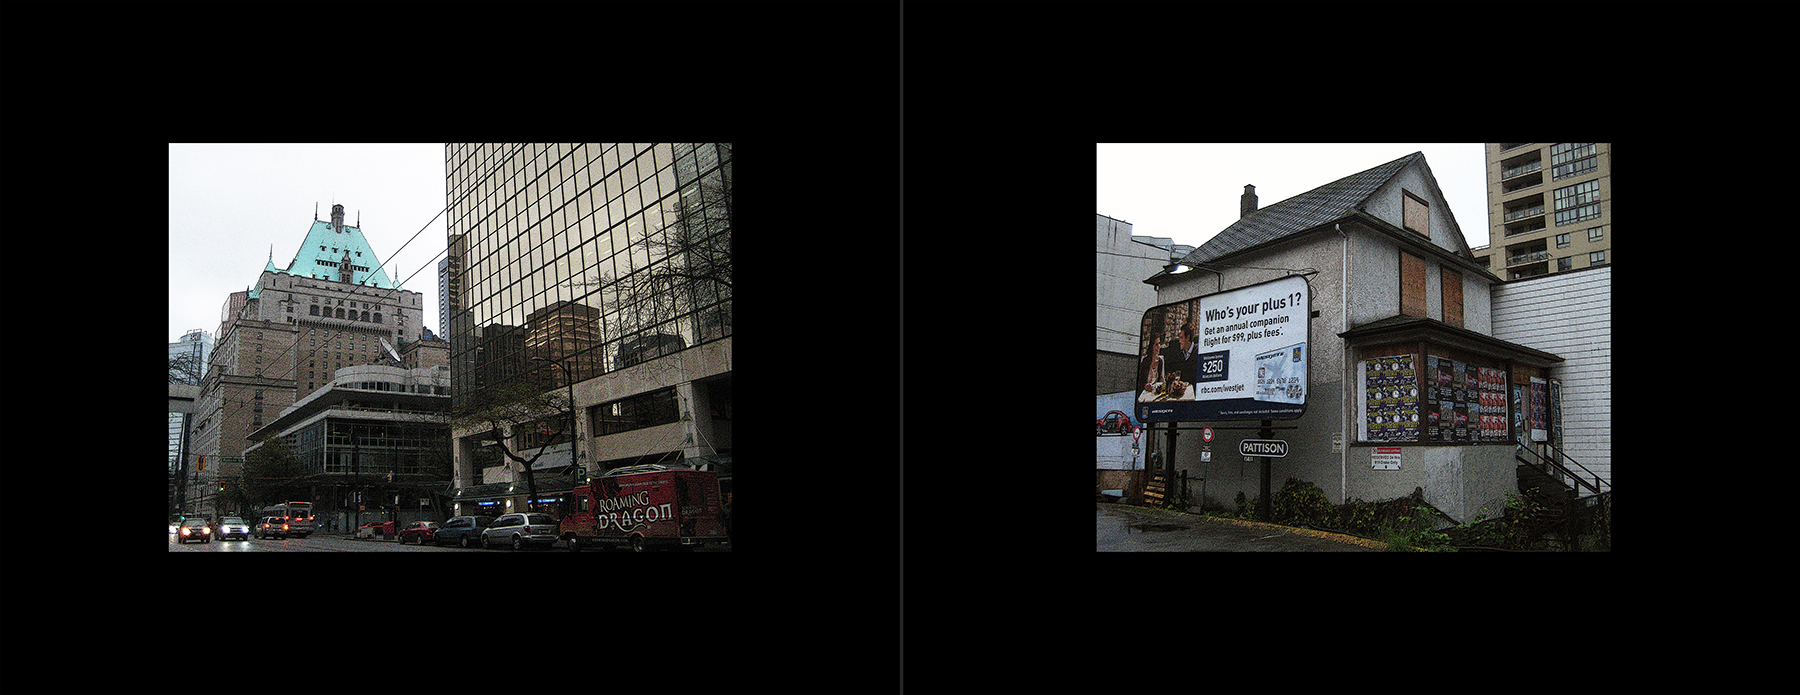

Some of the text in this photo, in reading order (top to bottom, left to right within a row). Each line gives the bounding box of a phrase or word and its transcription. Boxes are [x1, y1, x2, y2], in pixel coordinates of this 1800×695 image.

[1205, 291, 1302, 323] Who's your plus 1?
[1204, 314, 1290, 336] Get an annual companion
[1203, 335, 1221, 348] flight
[1221, 334, 1231, 345] for
[1231, 332, 1246, 344] $99,
[1247, 330, 1263, 343] plus
[1202, 359, 1223, 374] $250
[1242, 442, 1285, 454] PATTISON
[577, 467, 586, 480] P
[599, 490, 650, 513] ROAMING
[598, 502, 673, 533] DRAGON
